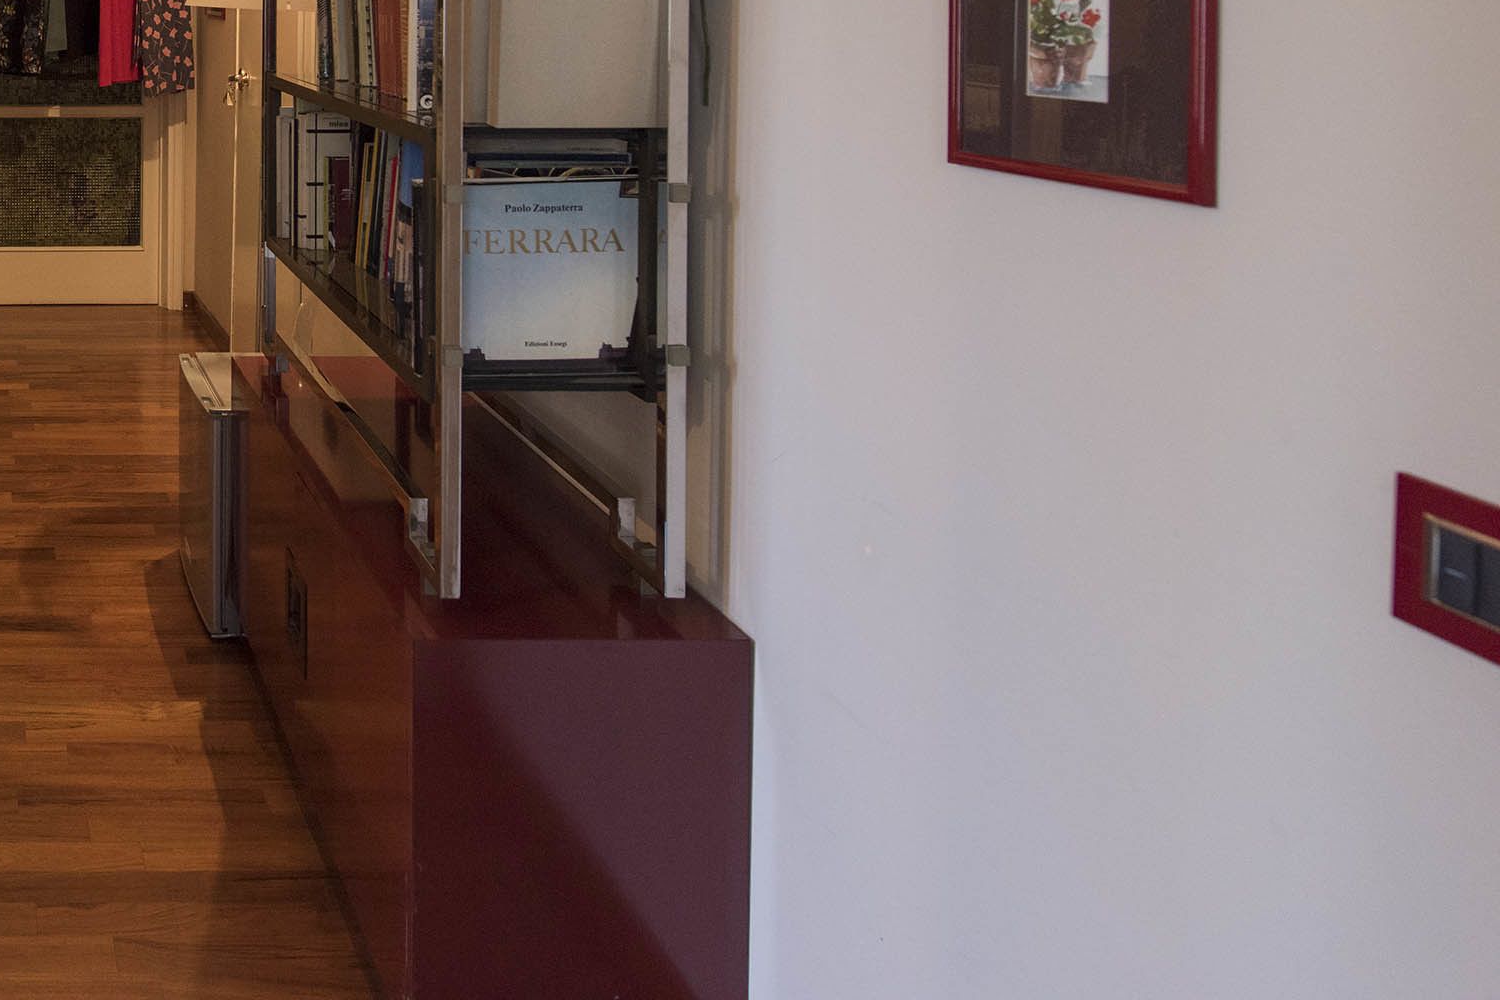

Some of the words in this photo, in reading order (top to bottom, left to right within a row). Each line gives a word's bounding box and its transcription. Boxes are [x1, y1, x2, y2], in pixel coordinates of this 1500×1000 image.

[504, 203, 532, 214] Paolo
[533, 203, 584, 215] Zappaterra
[463, 227, 626, 255] FERRARA
[524, 340, 549, 348] Edizioni
